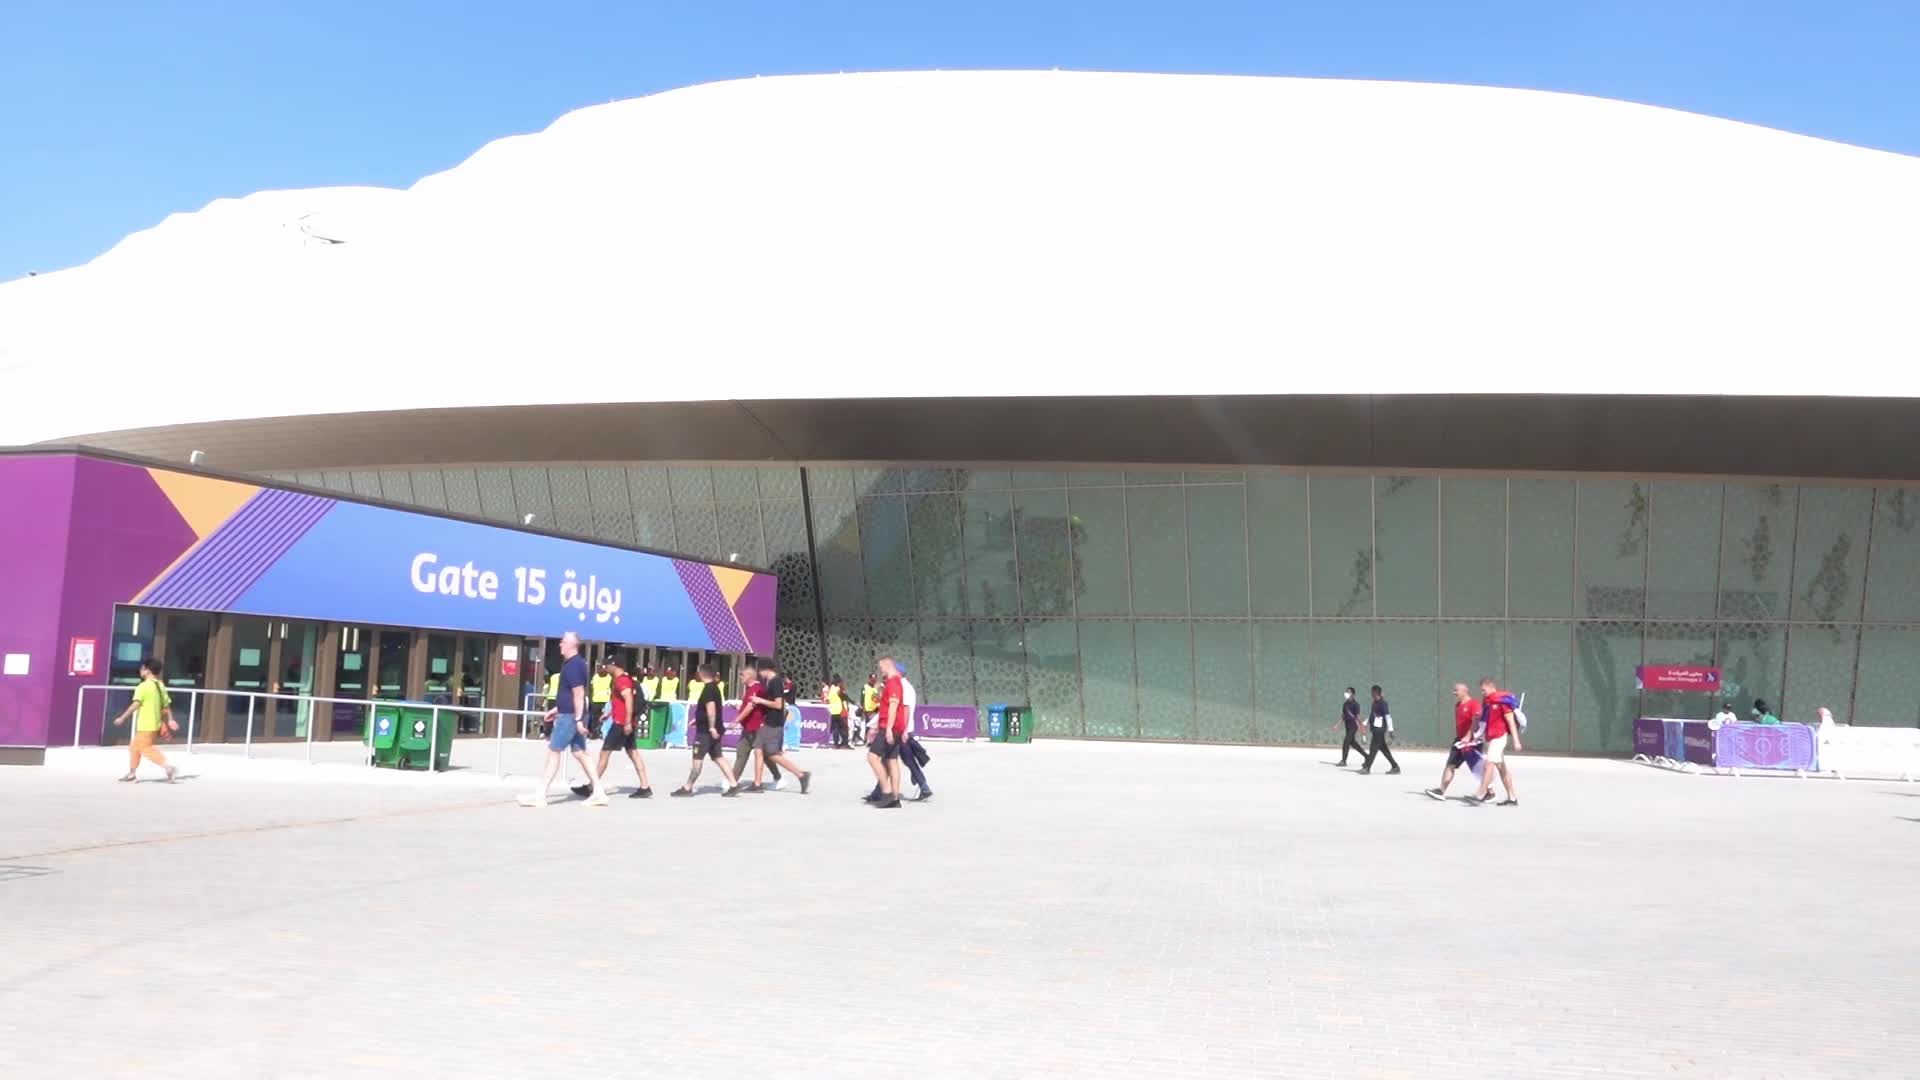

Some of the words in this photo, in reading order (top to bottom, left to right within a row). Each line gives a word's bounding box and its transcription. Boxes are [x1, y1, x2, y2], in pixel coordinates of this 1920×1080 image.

[411, 552, 499, 600] Gate
[514, 566, 546, 605] 15
[559, 569, 622, 624] بوابة
[800, 719, 827, 732] rldCup
